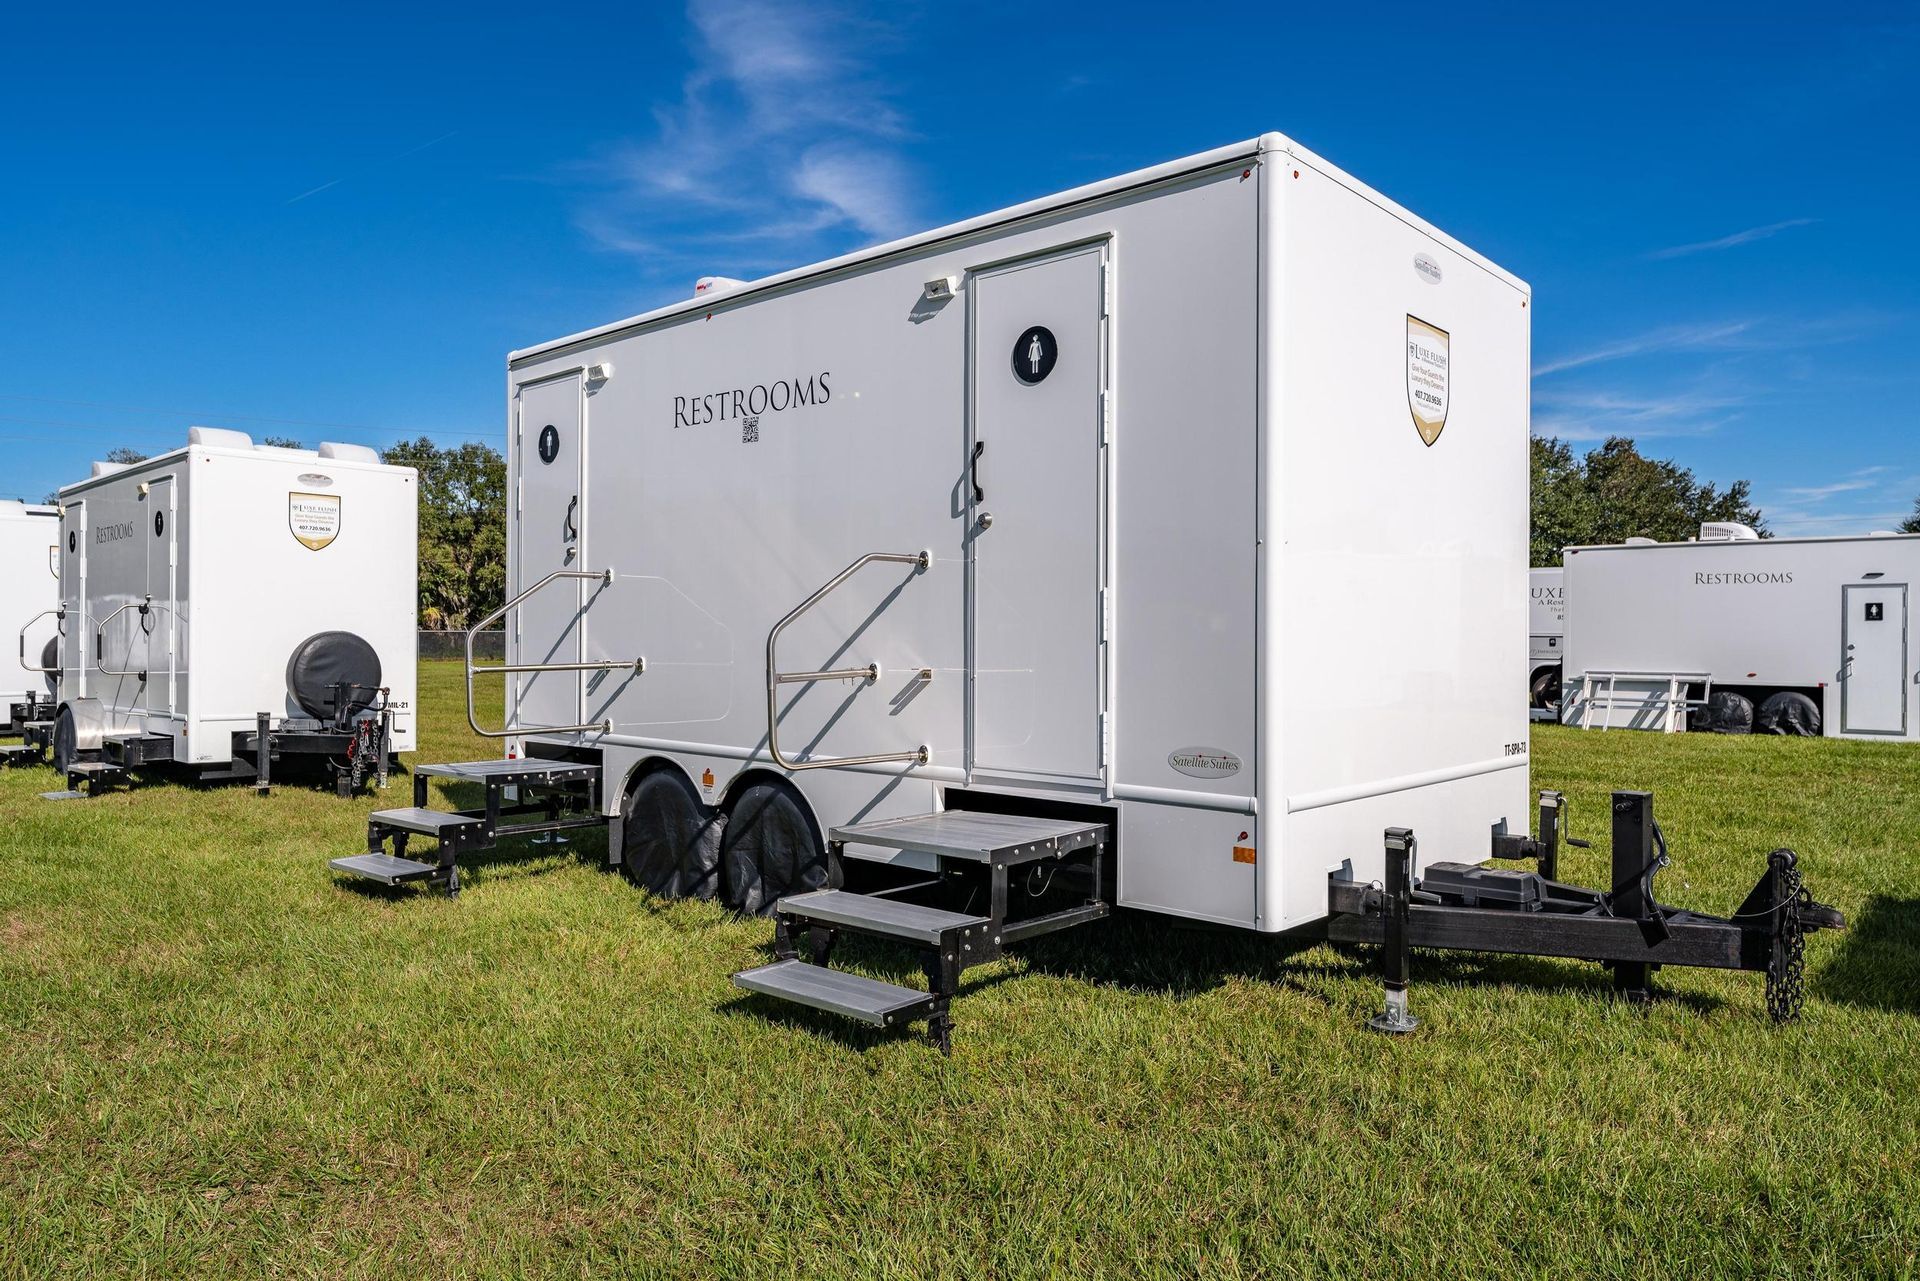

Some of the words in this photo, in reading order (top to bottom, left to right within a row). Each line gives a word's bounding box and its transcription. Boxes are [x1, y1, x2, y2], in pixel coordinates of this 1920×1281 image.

[673, 371, 831, 429] RESTROOMS
[96, 520, 134, 544] RESTROOMS
[1694, 571, 1793, 585] RESTROOMS
[1504, 741, 1526, 757] TT-SPA-73
[1173, 755, 1209, 769] Satellite
[1210, 758, 1239, 771] Suites
